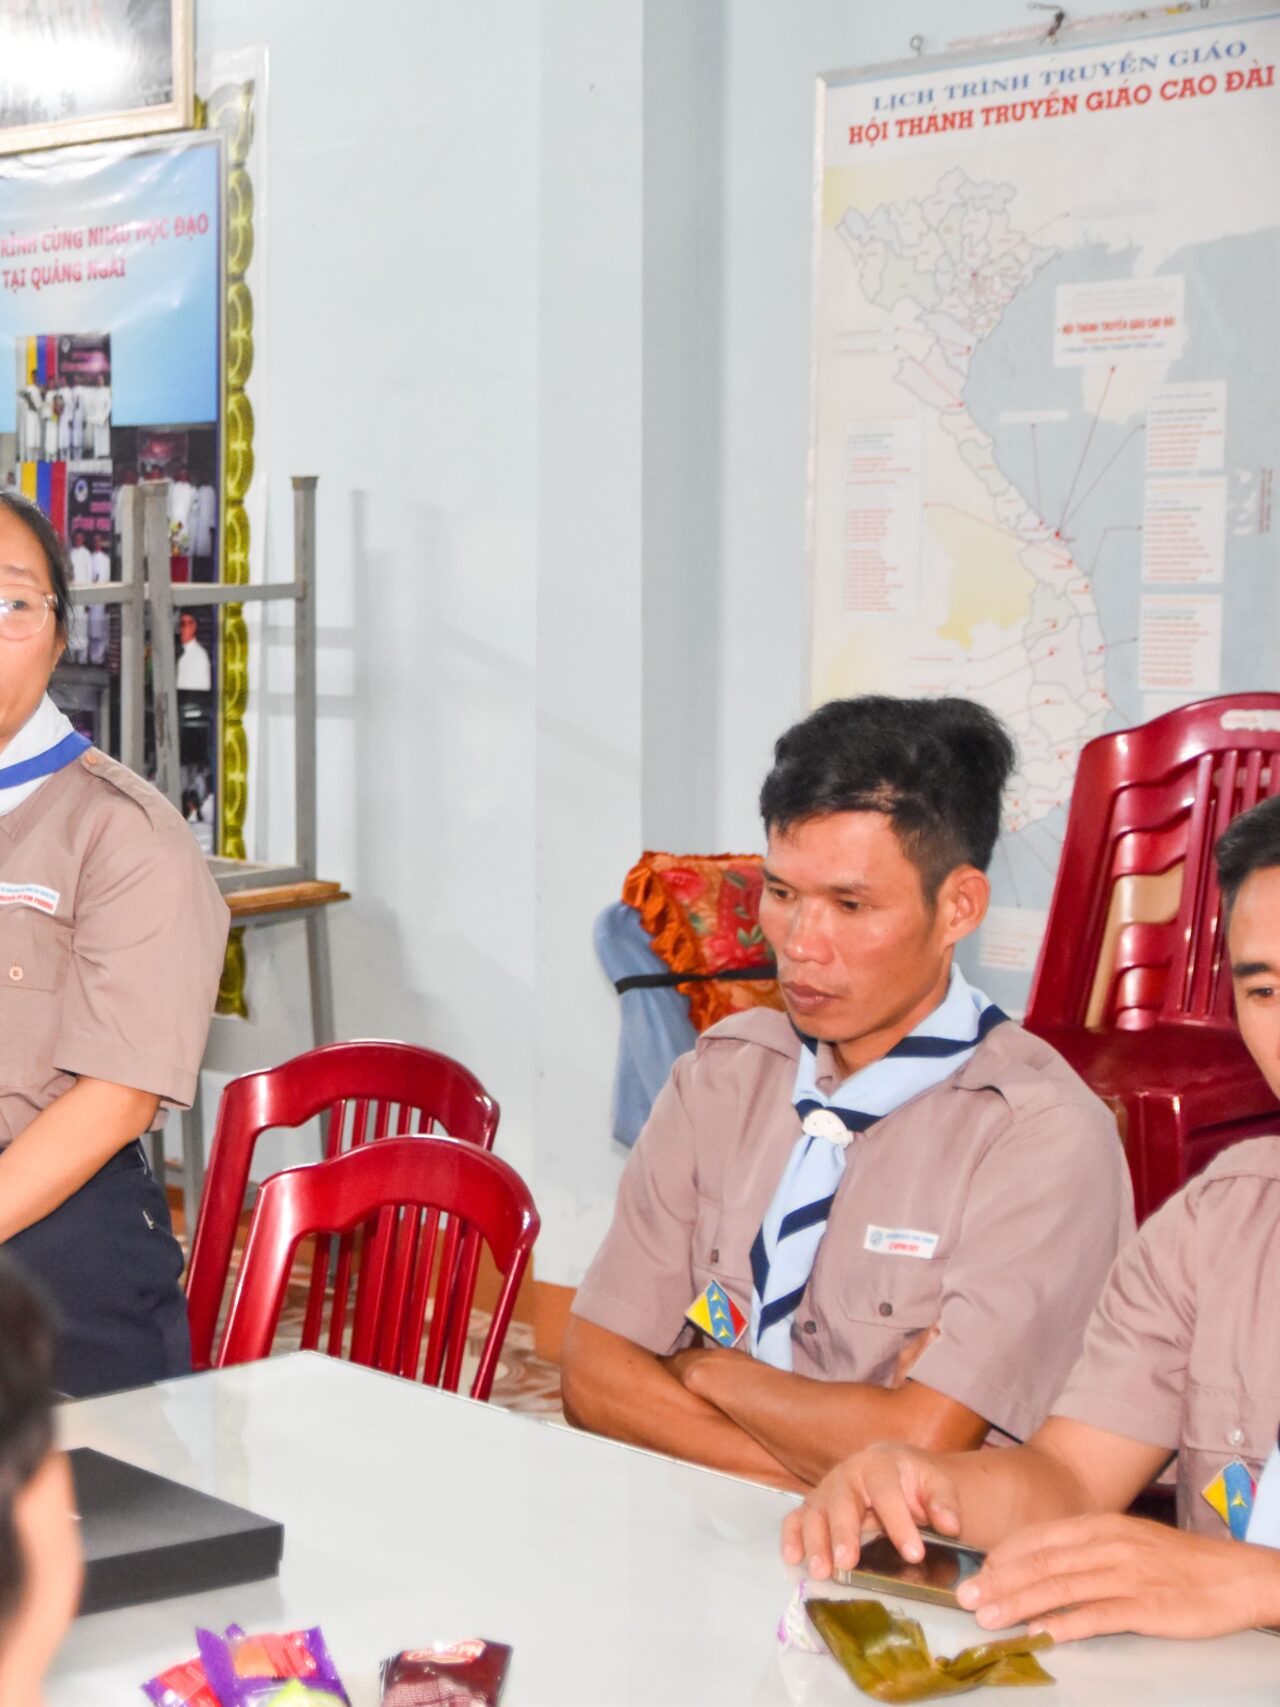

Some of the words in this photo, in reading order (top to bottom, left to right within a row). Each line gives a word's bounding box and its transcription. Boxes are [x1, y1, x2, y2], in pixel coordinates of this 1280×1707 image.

[873, 87, 934, 111] LỊCH
[943, 73, 1030, 100] TRÌNH
[1168, 39, 1248, 68] GIÁO
[848, 116, 889, 148] HỘI
[895, 106, 974, 139] THÁNH
[1085, 77, 1152, 112] GIÁO
[1160, 73, 1217, 101] CAO
[1225, 58, 1276, 93] ĐÀI
[174, 212, 209, 240] ĐẠO
[2, 268, 26, 293] TẠI
